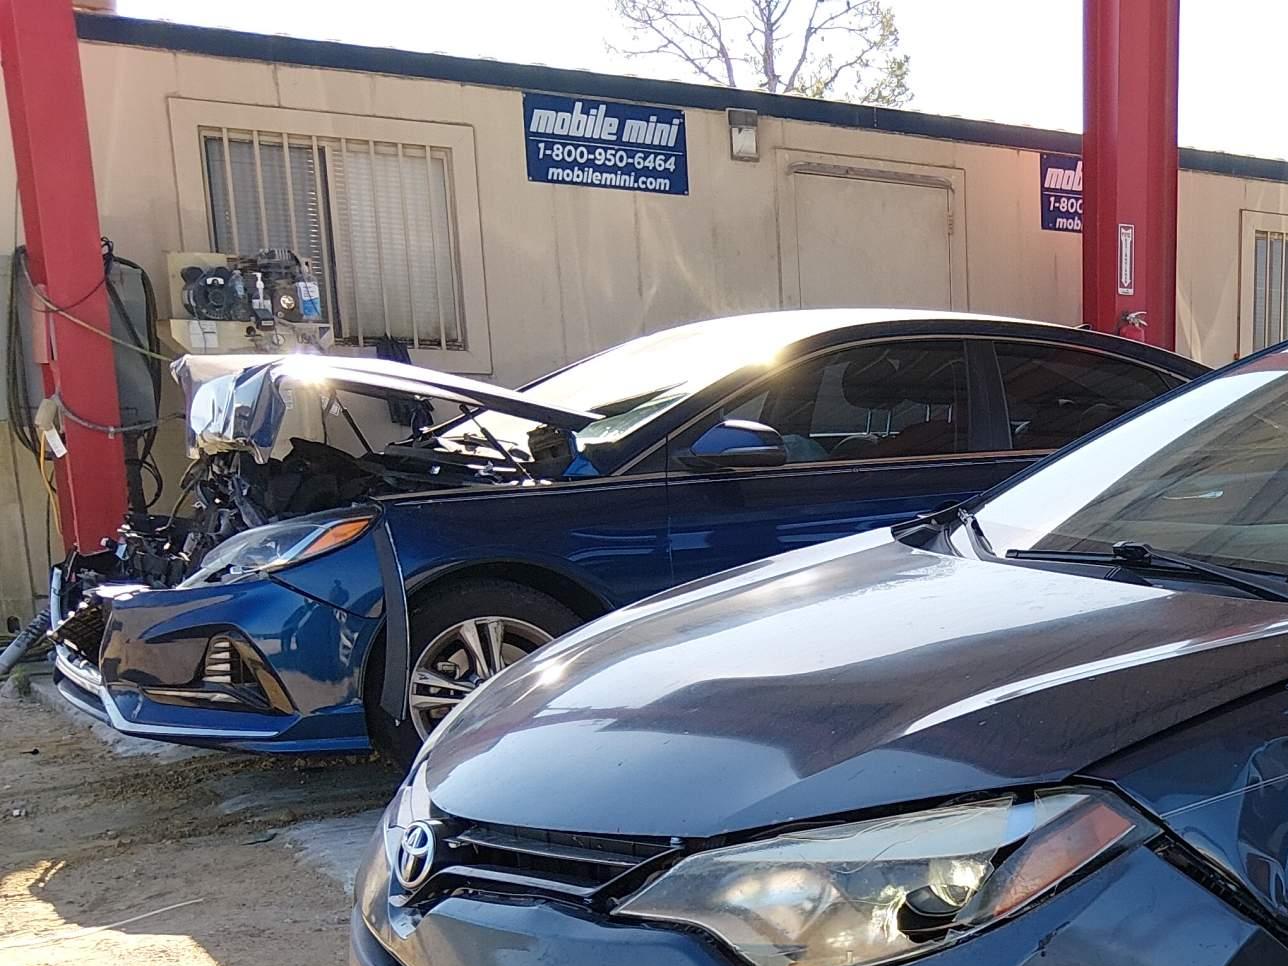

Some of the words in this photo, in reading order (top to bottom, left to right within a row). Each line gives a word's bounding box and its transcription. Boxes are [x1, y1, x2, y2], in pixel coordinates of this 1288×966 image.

[530, 101, 619, 140] mobile
[622, 115, 680, 147] mini
[538, 142, 676, 173] 1-800-950-6464
[547, 166, 670, 191] mobilemini.com
